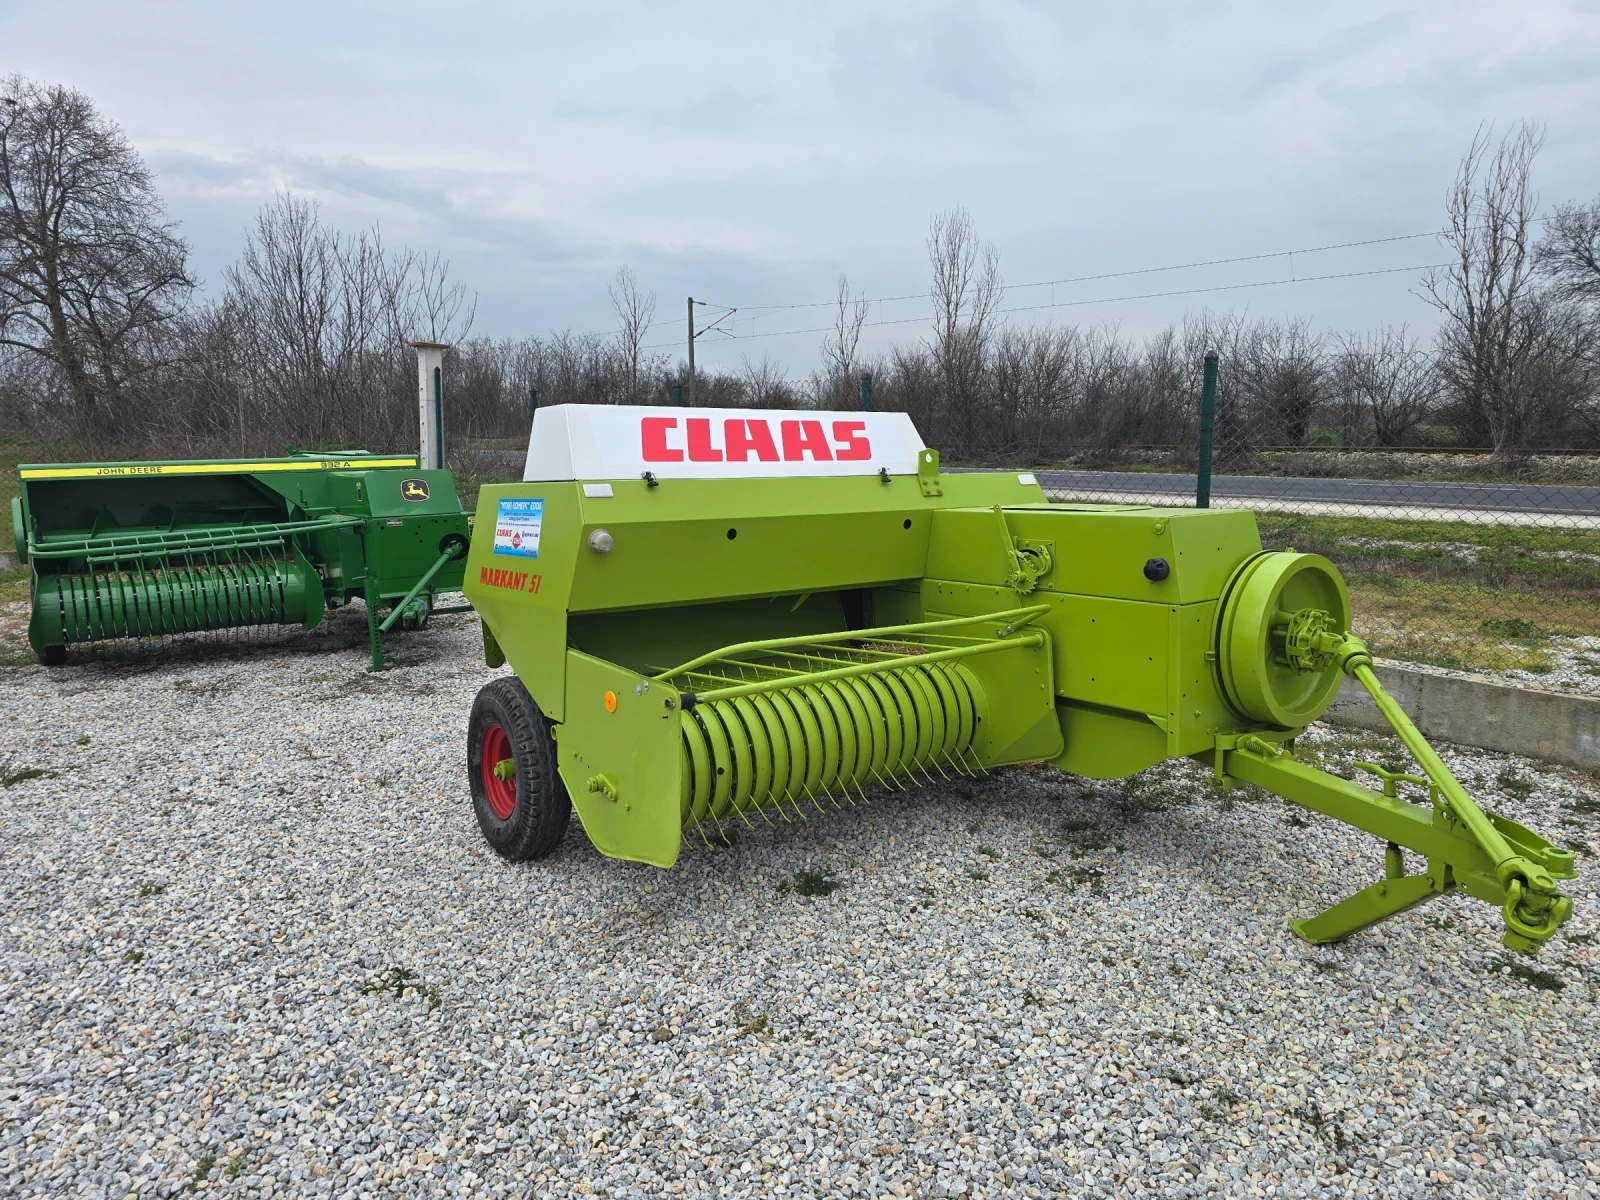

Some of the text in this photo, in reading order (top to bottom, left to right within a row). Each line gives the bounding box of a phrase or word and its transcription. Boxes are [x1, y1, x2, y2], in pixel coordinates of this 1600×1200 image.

[641, 417, 872, 462] CLAAS
[130, 466, 163, 474] DEERE
[480, 566, 542, 594] MARKANT 51
